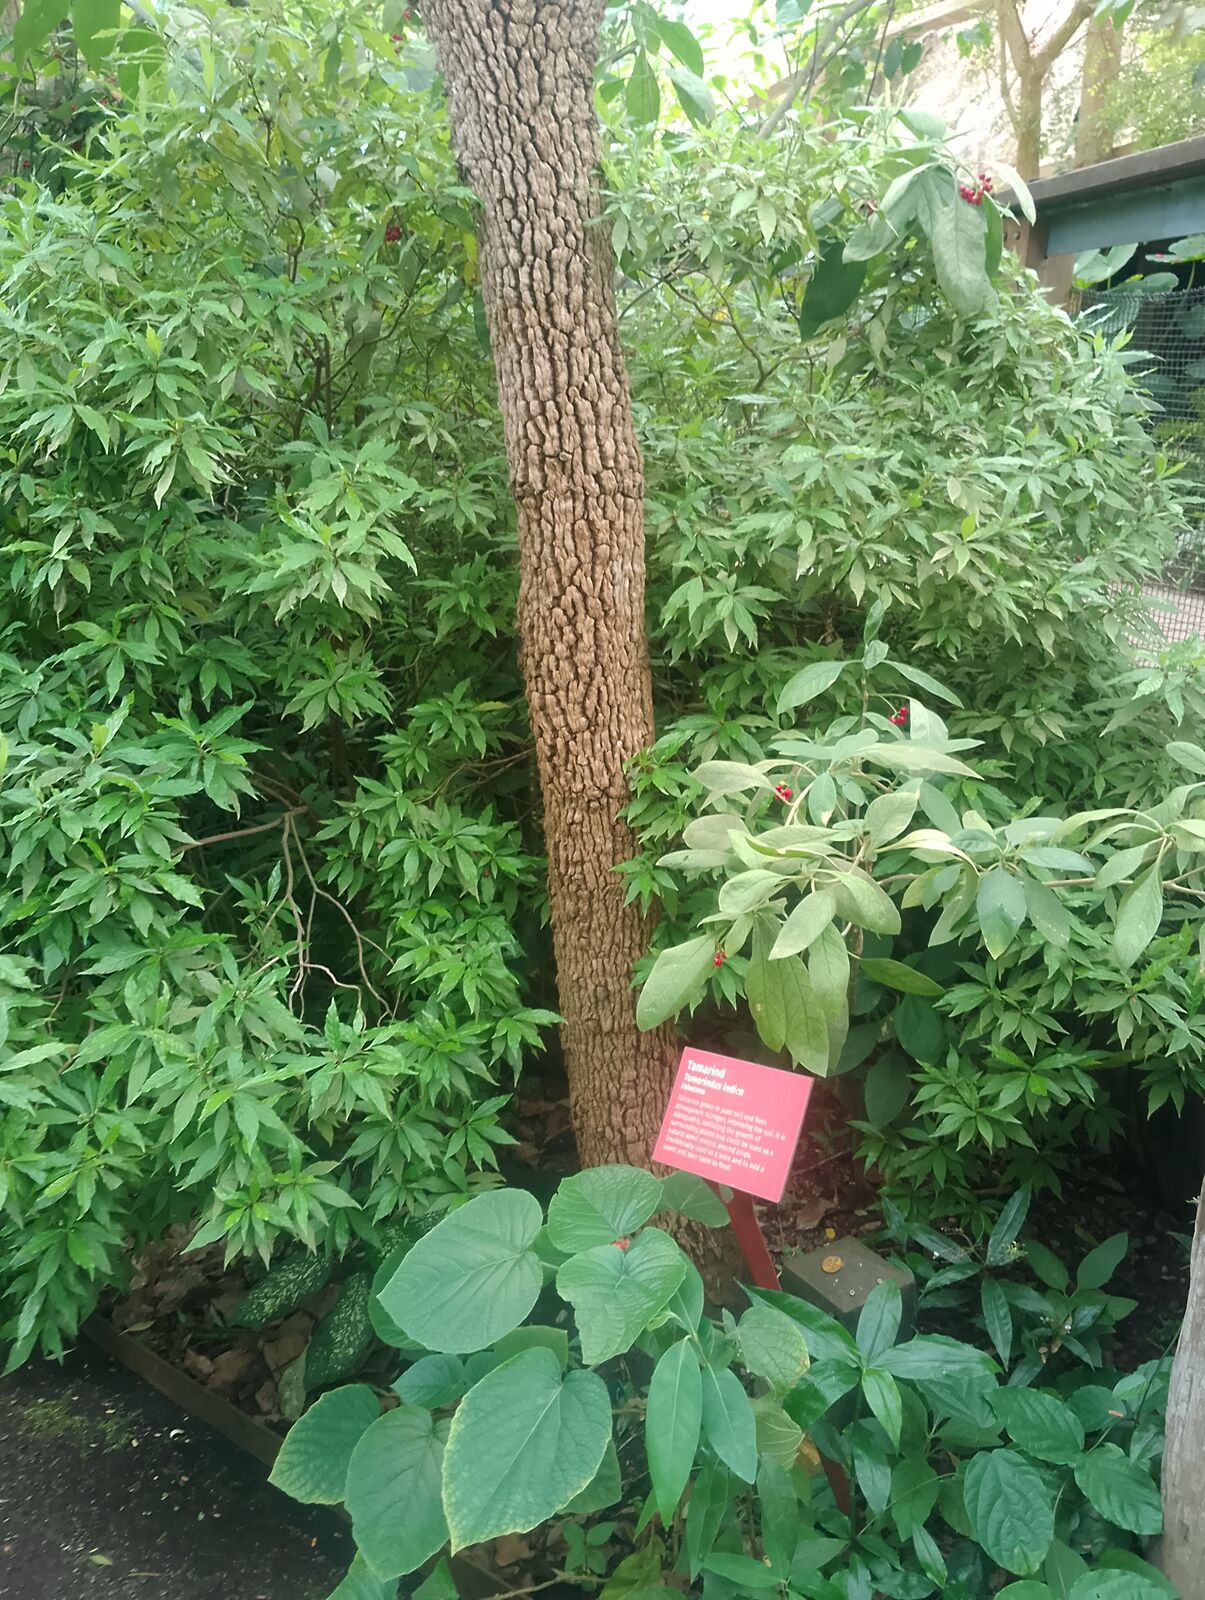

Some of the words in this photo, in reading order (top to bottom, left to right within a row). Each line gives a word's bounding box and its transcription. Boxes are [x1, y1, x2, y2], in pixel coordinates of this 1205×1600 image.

[687, 1059, 726, 1078] Tamarind
[683, 1072, 722, 1090] Tamarindus
[722, 1082, 744, 1096] indica
